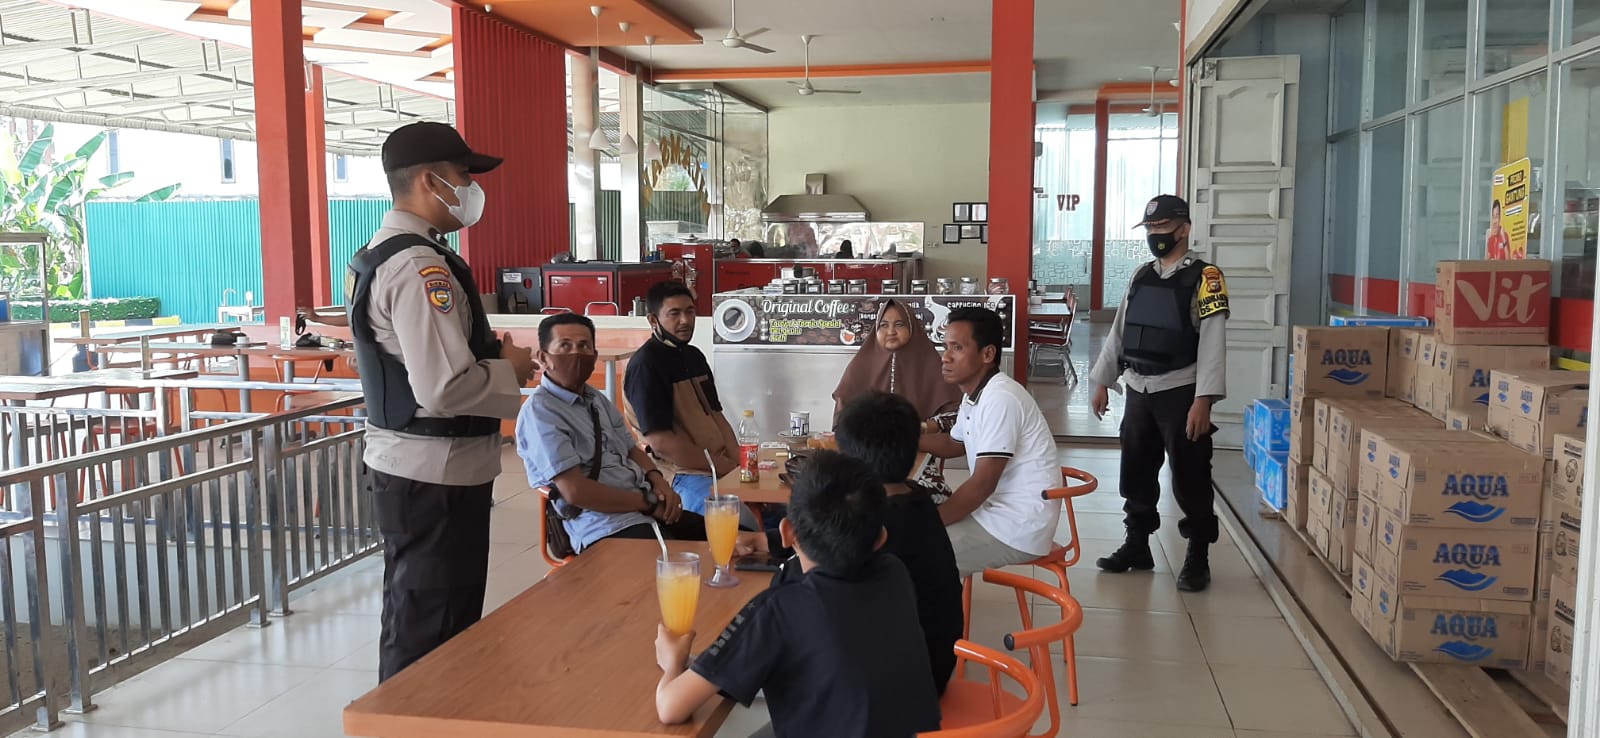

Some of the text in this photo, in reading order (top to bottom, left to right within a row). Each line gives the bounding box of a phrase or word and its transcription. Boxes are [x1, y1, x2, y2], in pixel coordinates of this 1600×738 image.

[1057, 194, 1080, 211] VIP
[761, 299, 812, 317] Original
[814, 299, 849, 318] Coffee
[1456, 272, 1547, 324] Vit
[1321, 349, 1372, 368] AQUA
[1470, 369, 1490, 387] A
[1442, 474, 1509, 500] AQUA
[1433, 543, 1501, 568] AQUA
[1431, 613, 1498, 640] AQUA
